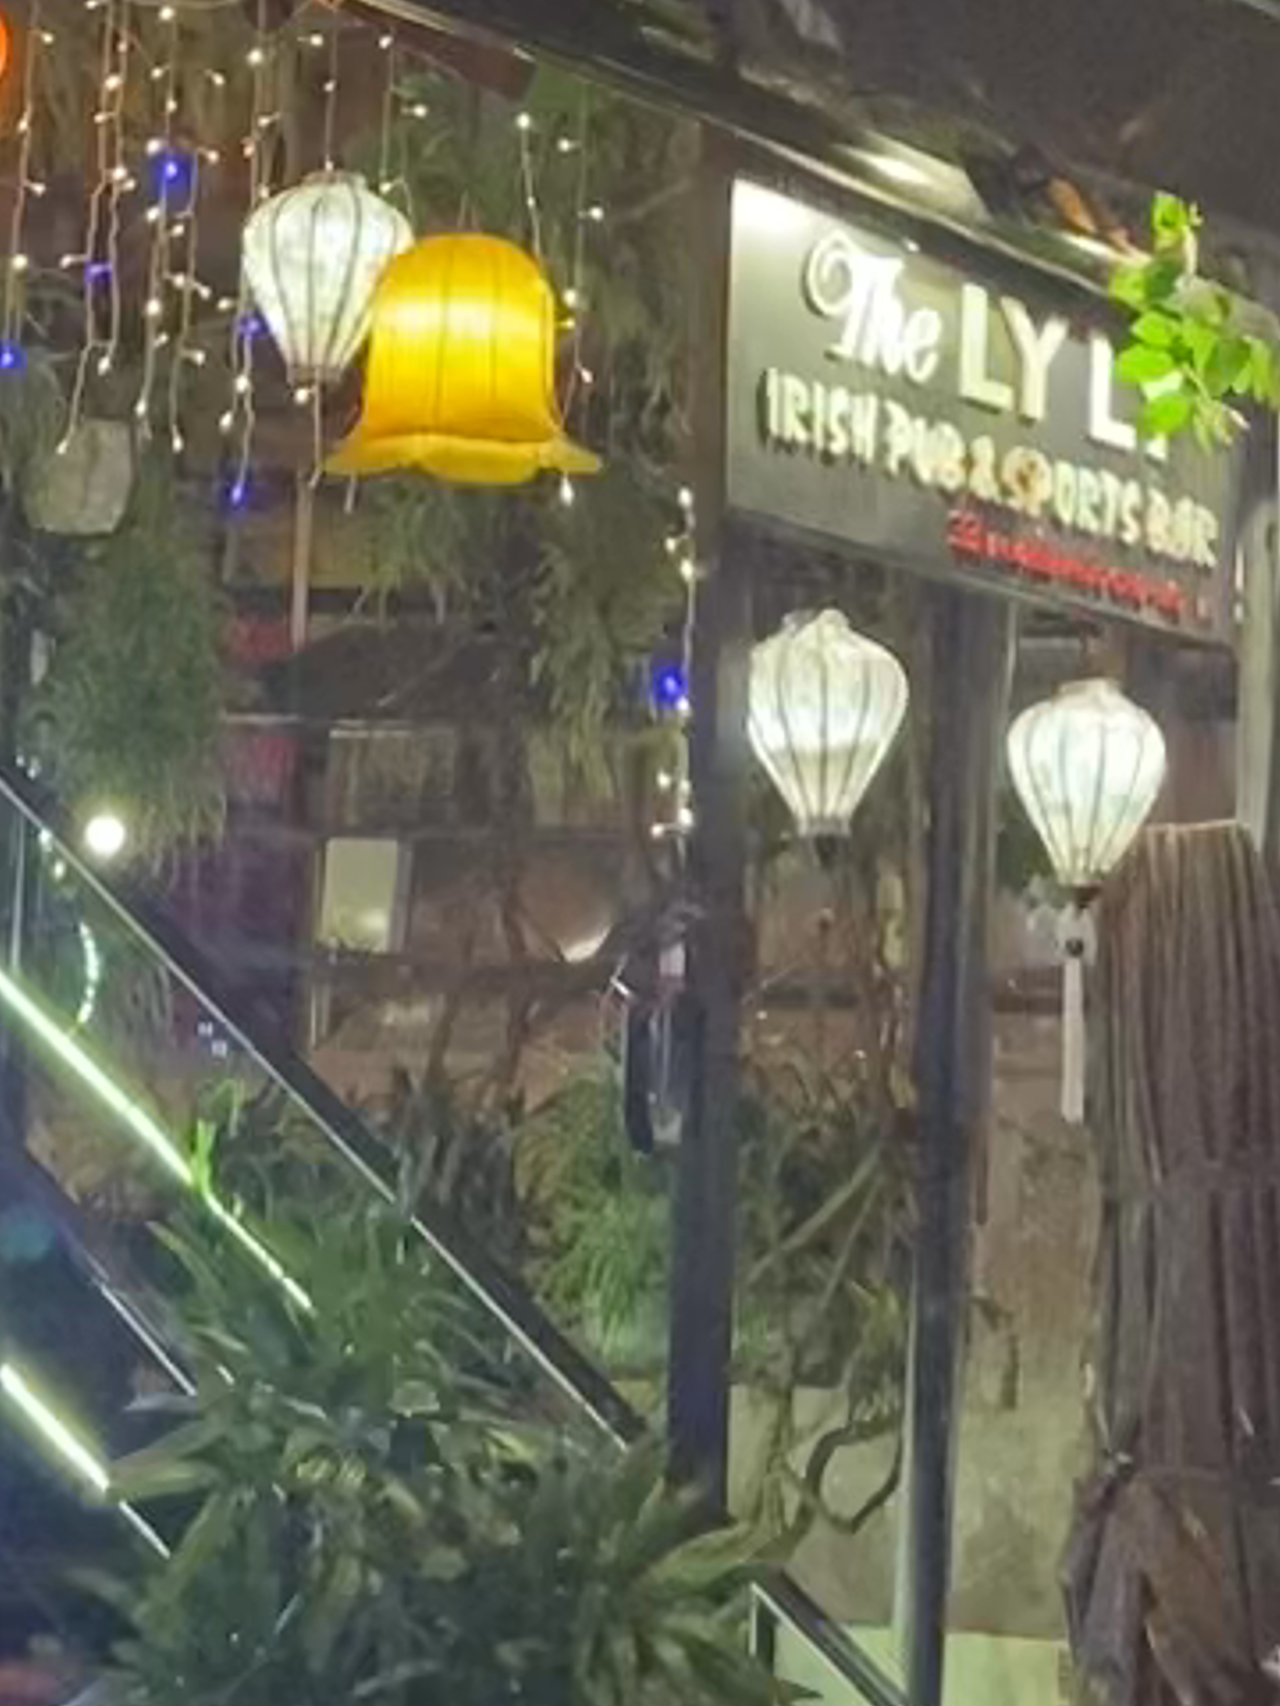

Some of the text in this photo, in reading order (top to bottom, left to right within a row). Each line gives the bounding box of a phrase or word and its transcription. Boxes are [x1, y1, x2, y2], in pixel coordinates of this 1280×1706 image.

[805, 229, 943, 384] The
[764, 366, 878, 464] IRISH
[883, 397, 967, 492] PUB
[969, 434, 1003, 505] &
[1145, 485, 1219, 569] BAR
